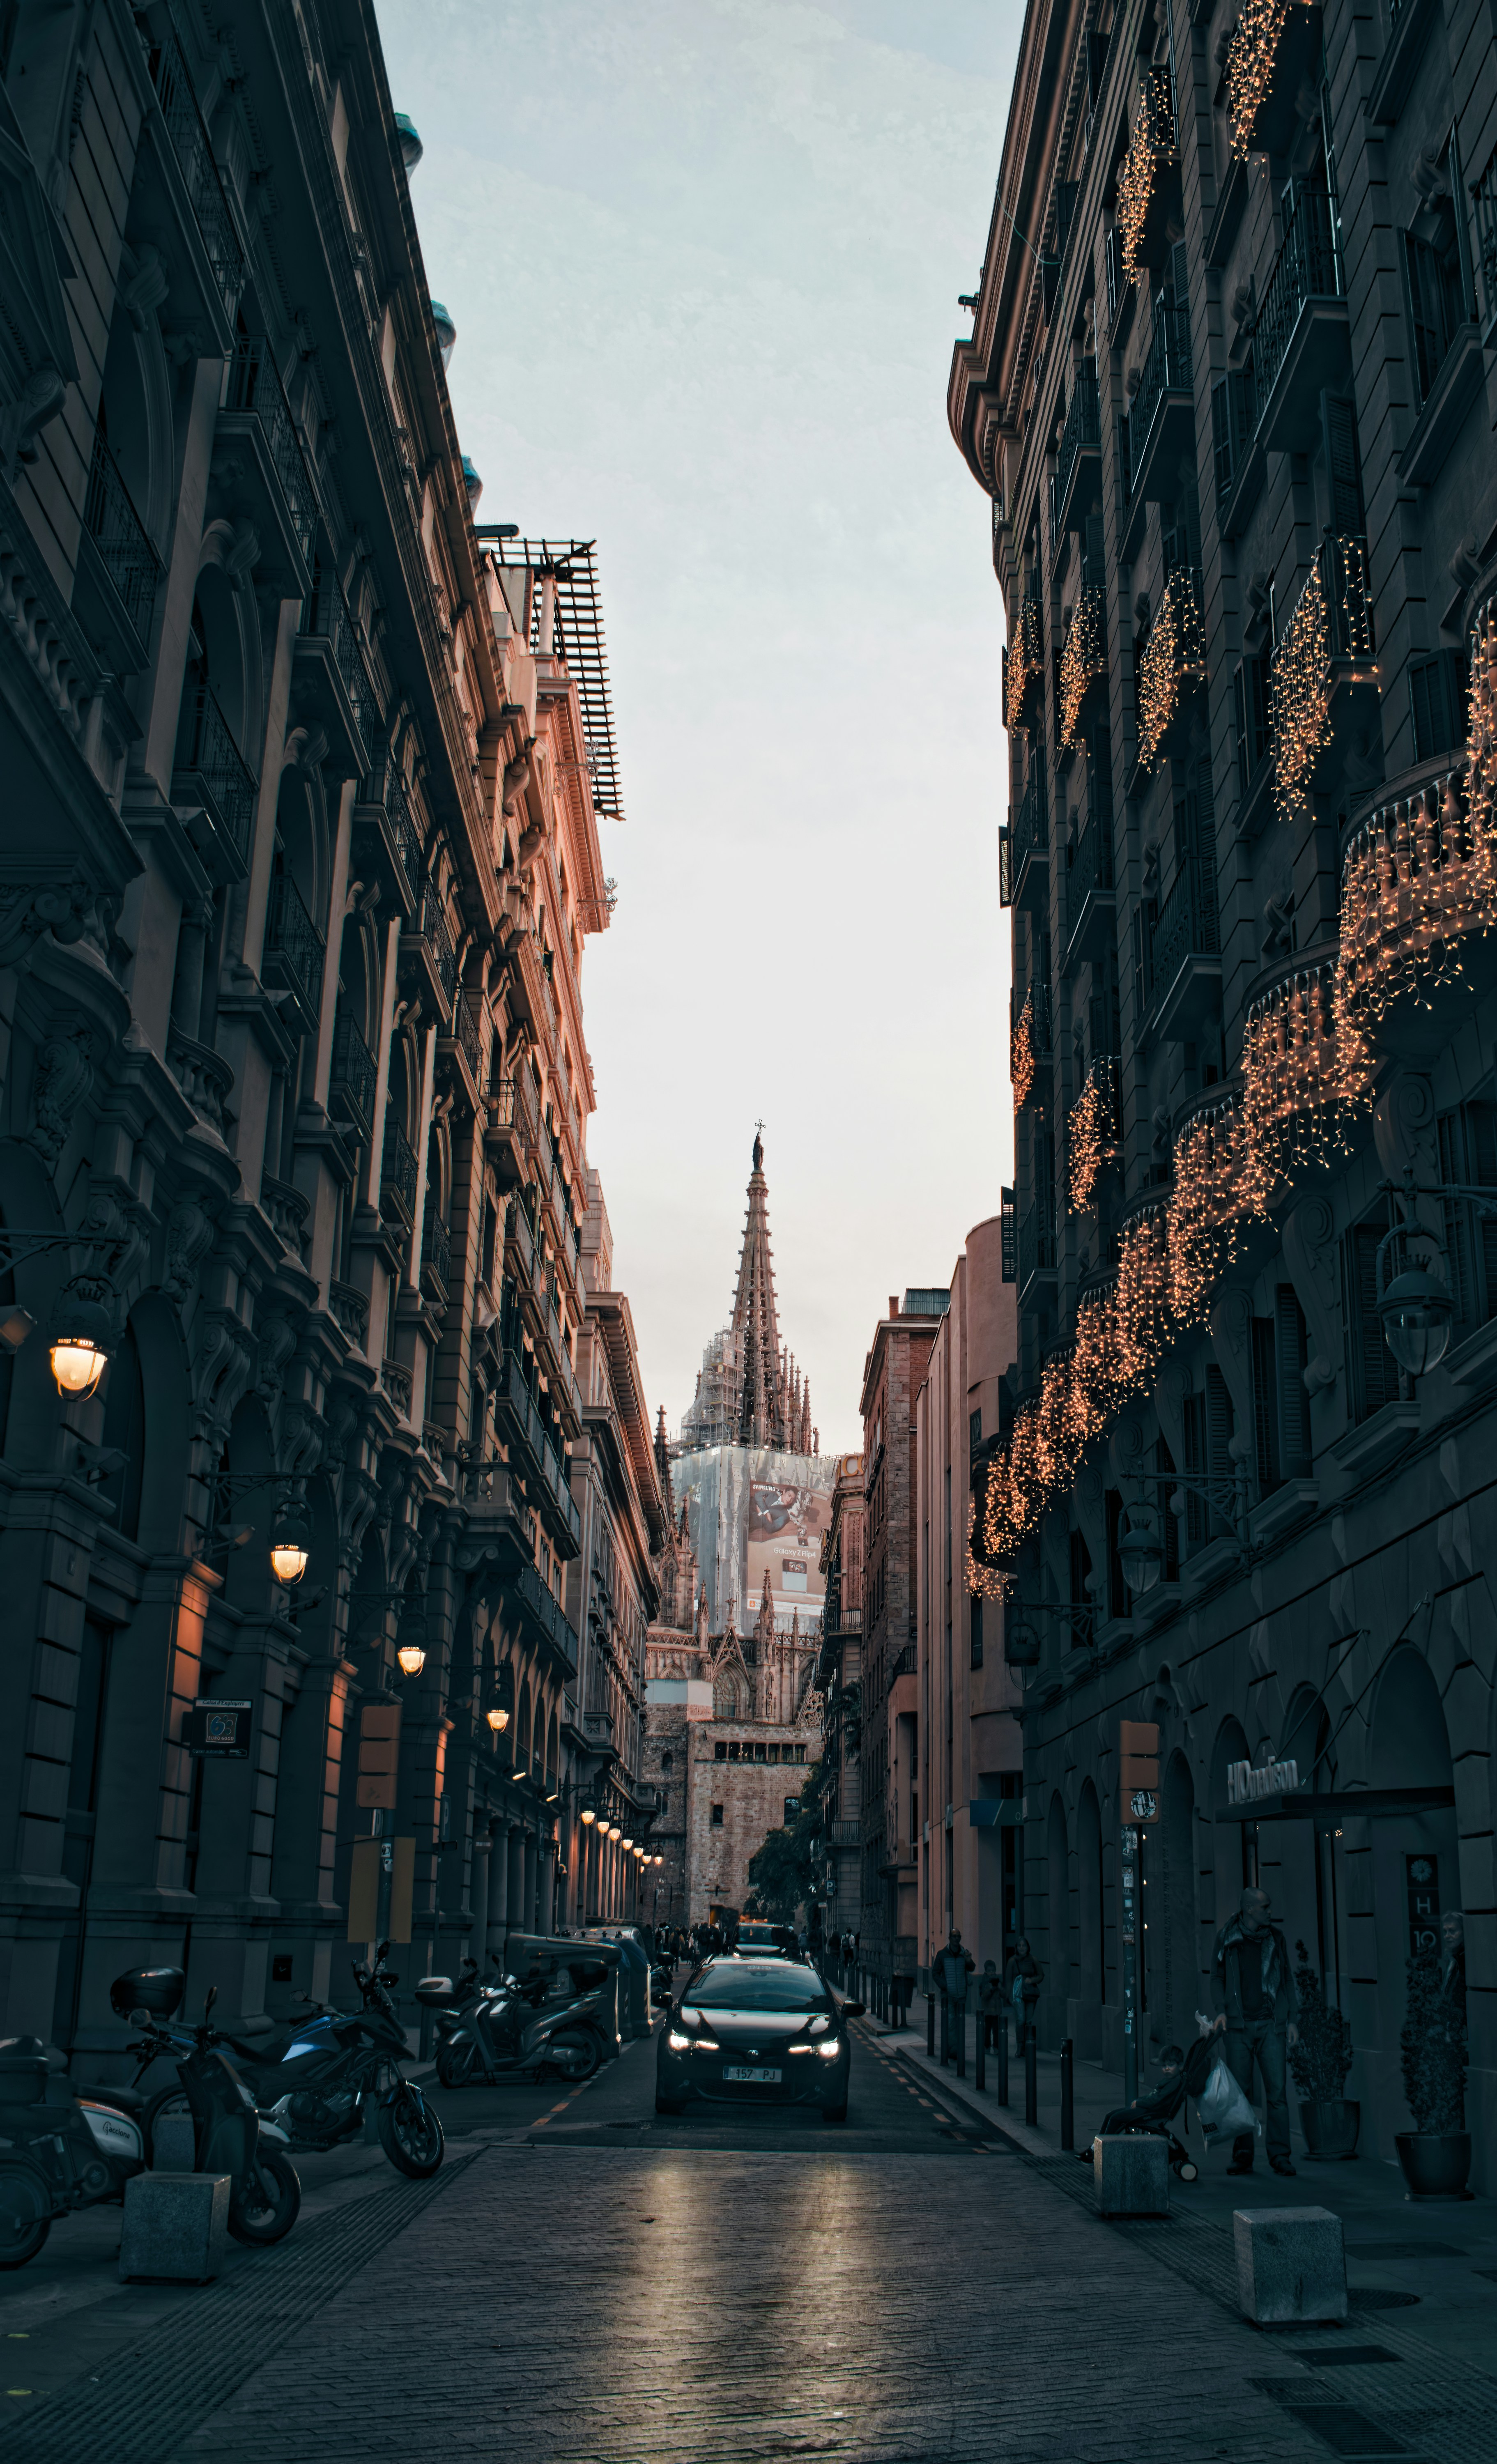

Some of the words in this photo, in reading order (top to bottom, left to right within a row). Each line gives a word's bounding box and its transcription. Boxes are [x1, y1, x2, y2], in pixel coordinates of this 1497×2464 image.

[774, 1547, 796, 1556] Galaxy
[802, 1551, 816, 1559] Flip4
[827, 1881, 833, 1890] P
[1417, 1896, 1431, 1914] H
[1414, 1931, 1437, 1948] 10
[736, 2069, 753, 2079] 157
[763, 2069, 775, 2080] PJ
[109, 2127, 130, 2139] acciona
